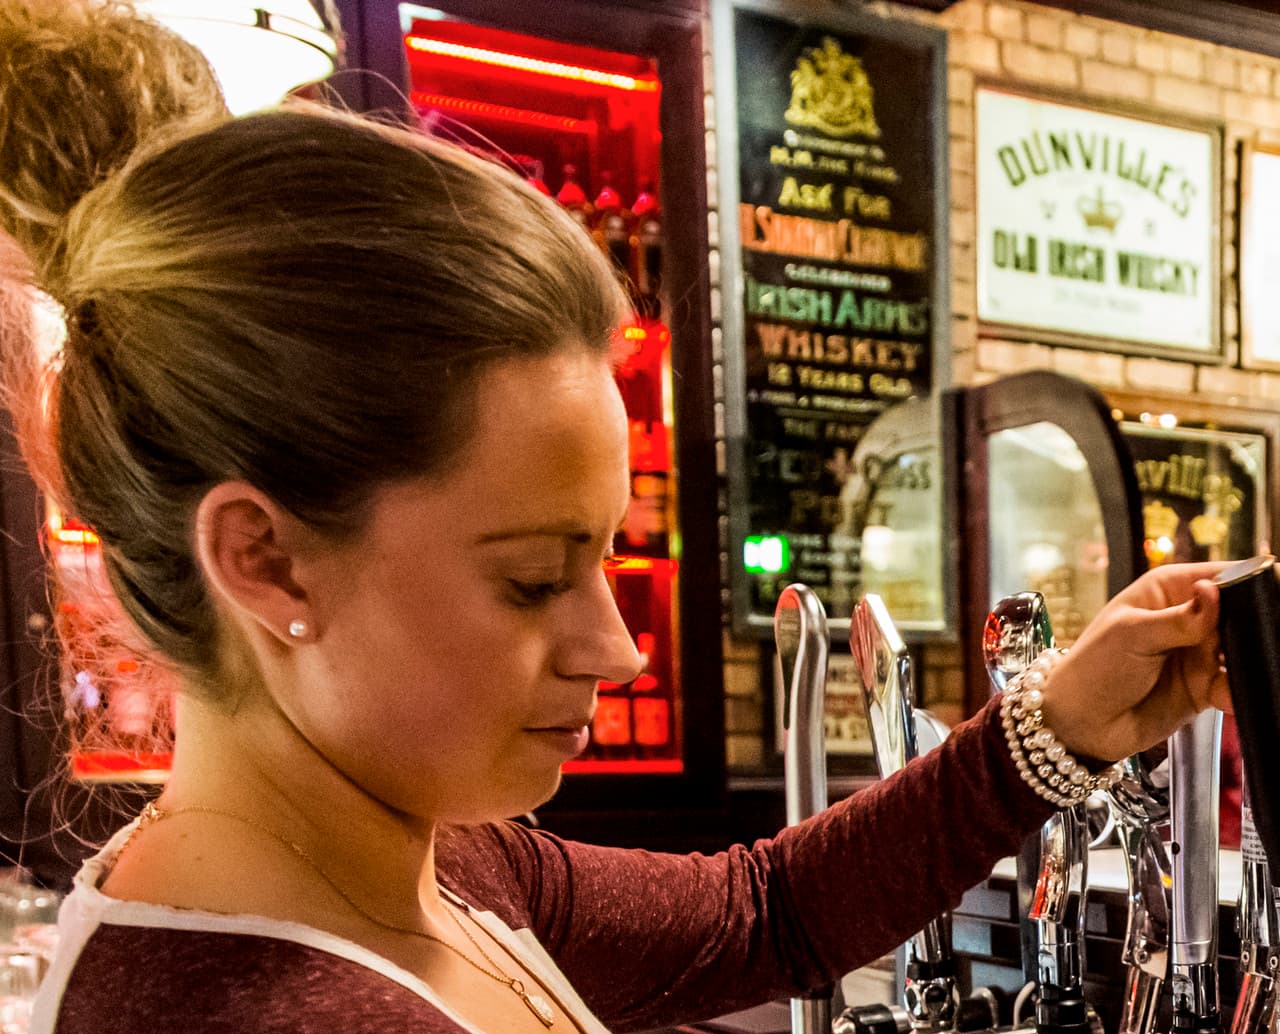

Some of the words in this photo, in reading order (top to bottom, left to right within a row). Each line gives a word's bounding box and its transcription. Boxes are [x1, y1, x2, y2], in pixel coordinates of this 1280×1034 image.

[992, 228, 1038, 274] OLD
[1048, 237, 1106, 283] IRISH
[1115, 250, 1199, 298] WHISKY
[756, 323, 918, 372] WHISKEY
